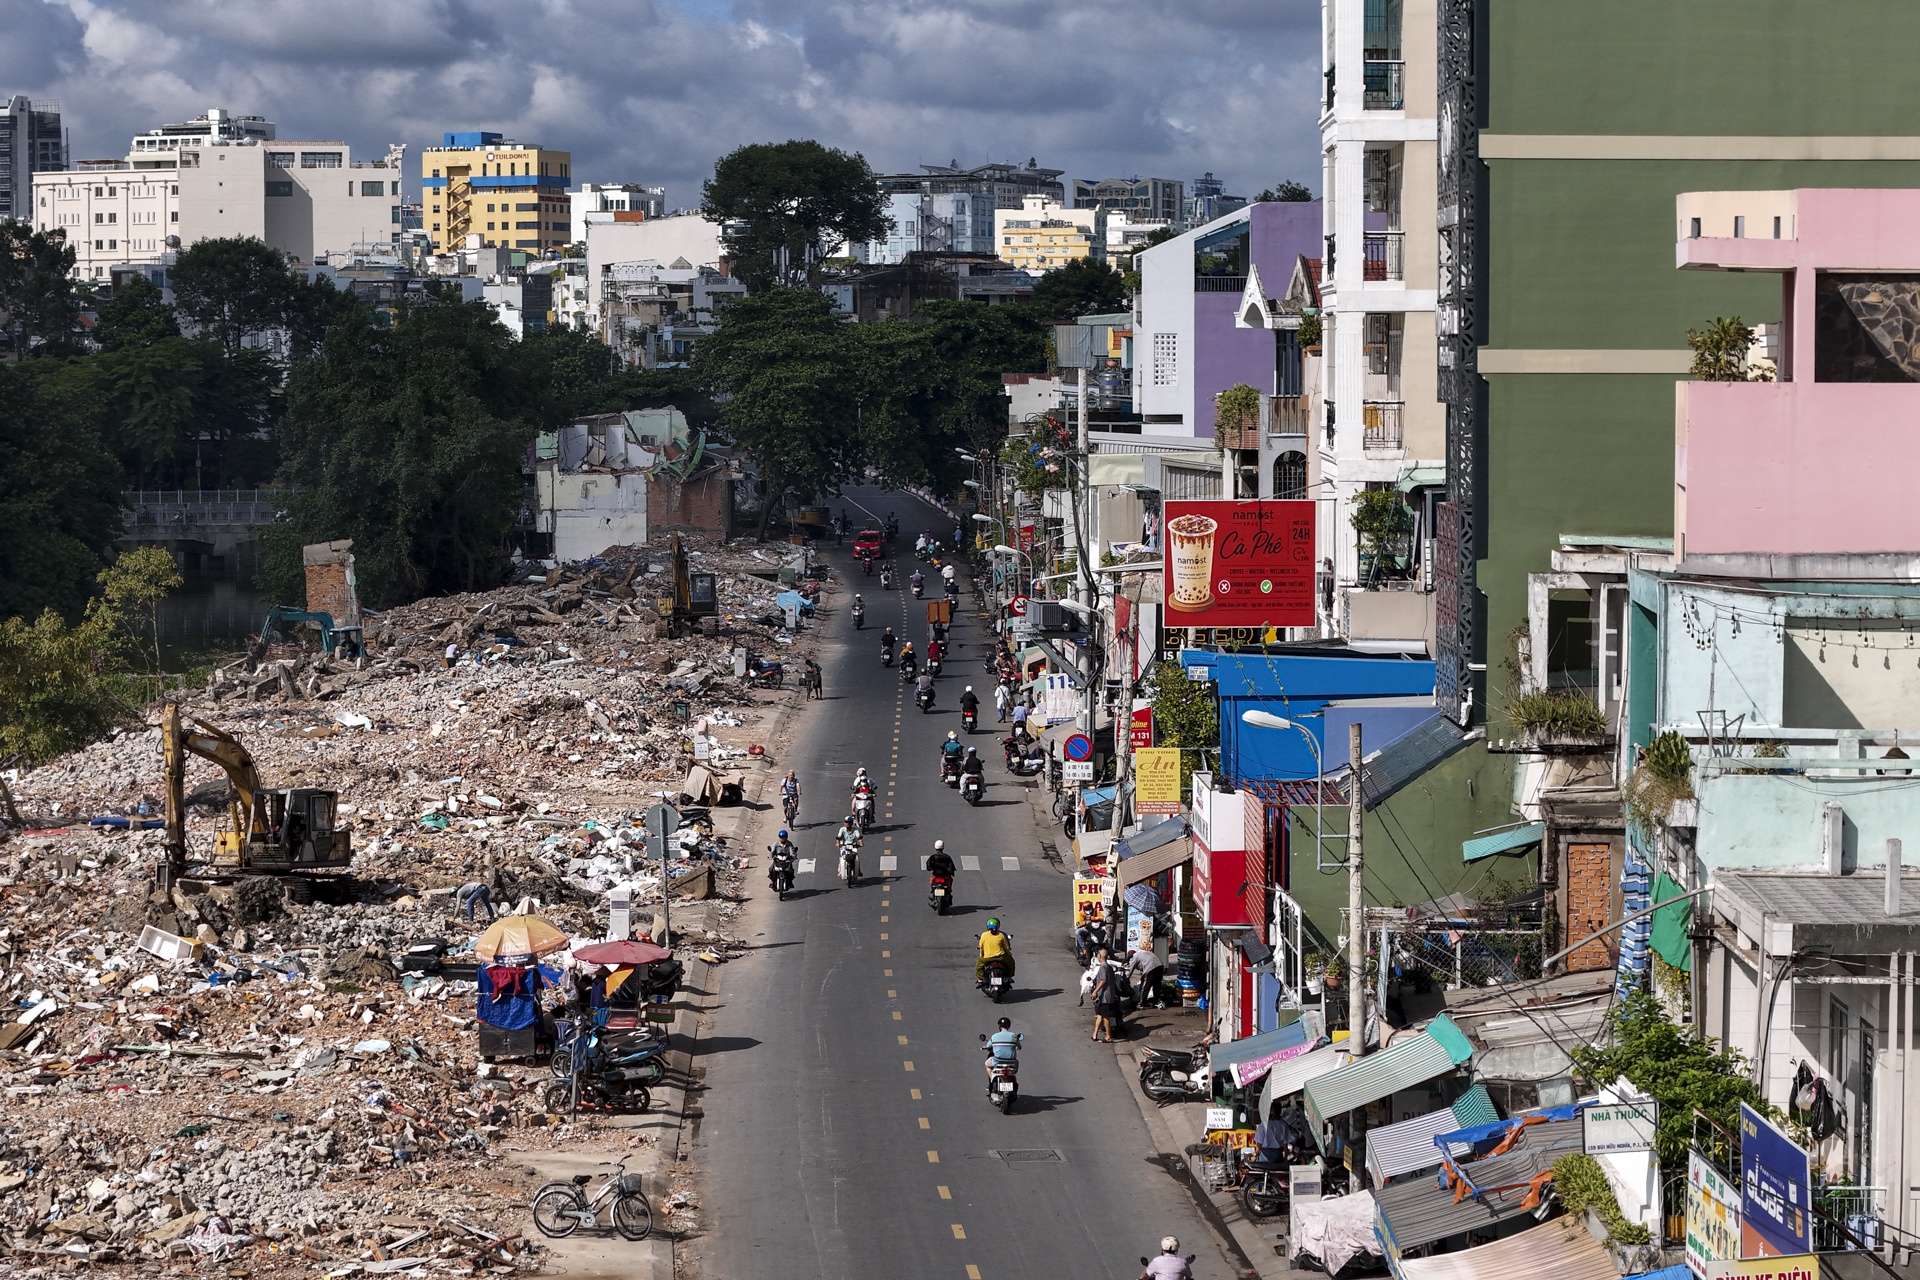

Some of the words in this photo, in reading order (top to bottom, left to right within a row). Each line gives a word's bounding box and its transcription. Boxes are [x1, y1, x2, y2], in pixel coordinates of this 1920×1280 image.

[1292, 527, 1310, 540] 24H
[1220, 531, 1248, 560] Cà
[1252, 530, 1284, 559] Phê
[1163, 628, 1254, 650] BEER
[1163, 651, 1174, 660] IS
[1137, 732, 1150, 740] 131
[1139, 755, 1178, 771] An
[1591, 1109, 1611, 1122] NHÀ
[1614, 1105, 1647, 1121] THUỐC
